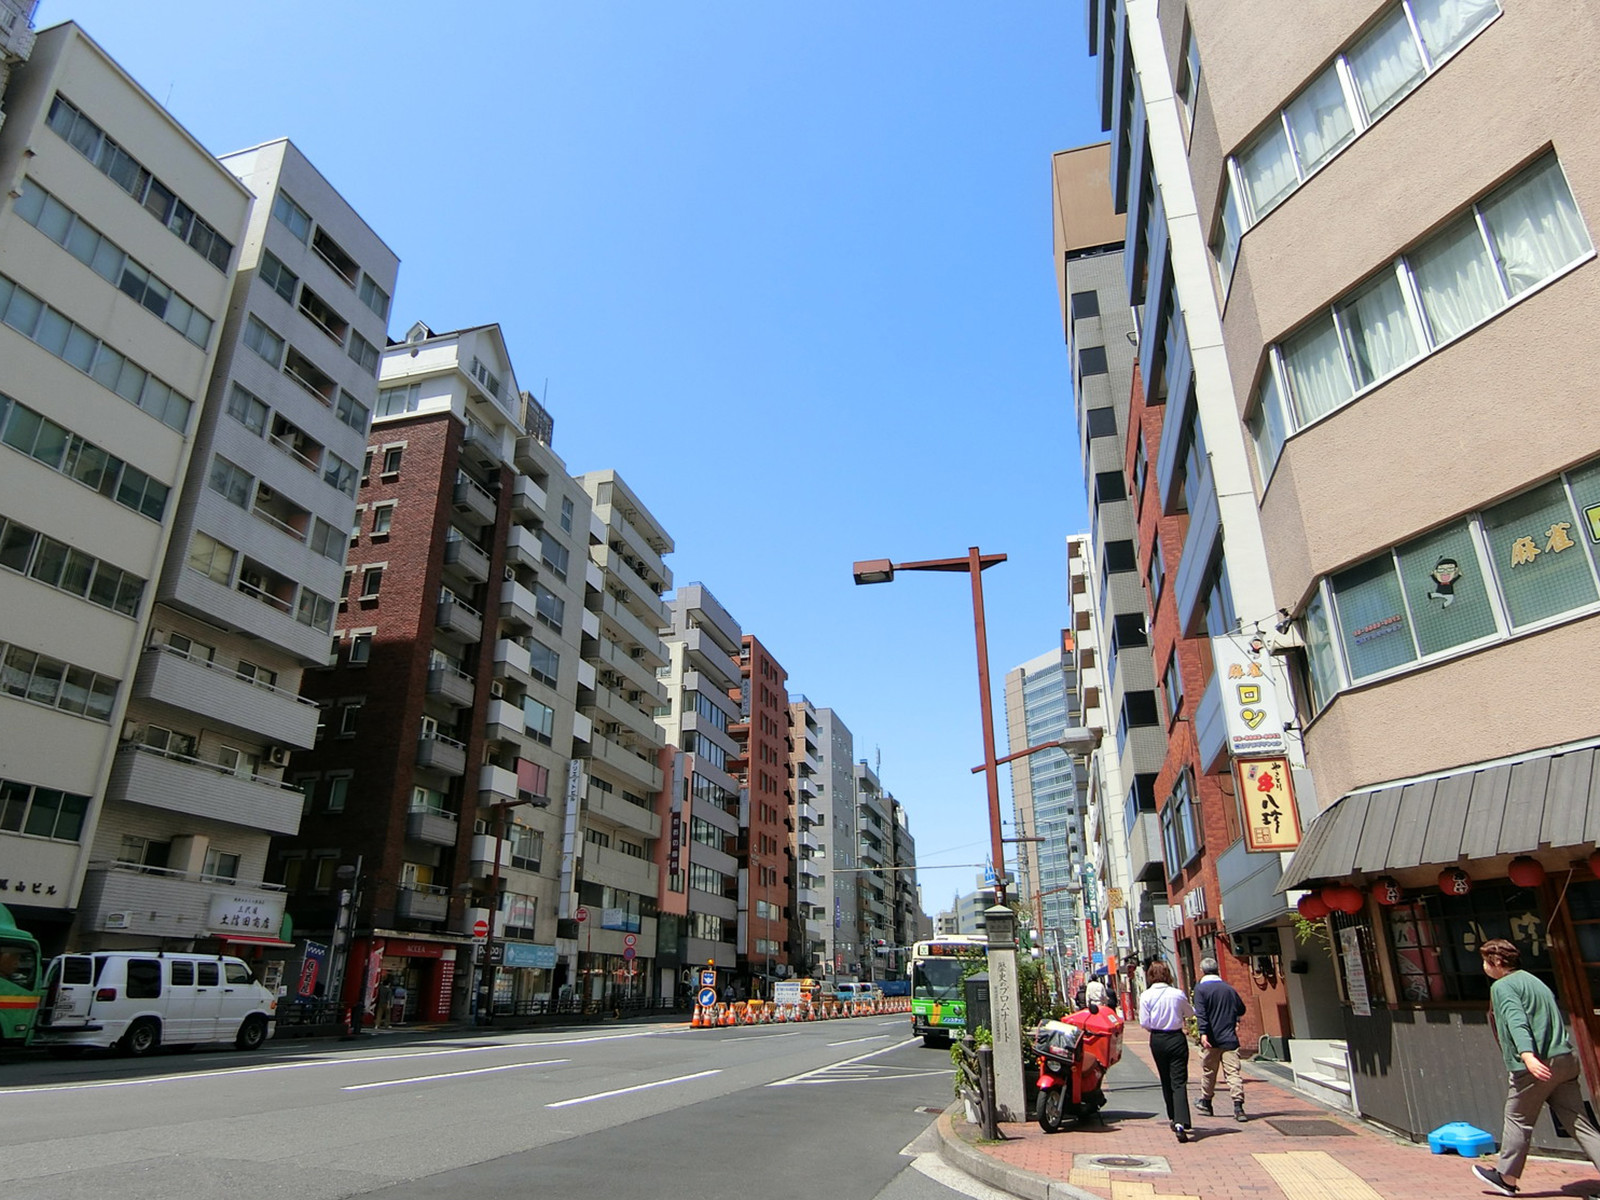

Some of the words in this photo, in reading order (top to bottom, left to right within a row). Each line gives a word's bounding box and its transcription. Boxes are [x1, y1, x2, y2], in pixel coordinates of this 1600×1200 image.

[1511, 521, 1575, 569] 麻雀
[407, 945, 426, 953] ACCEA
[998, 961, 1011, 1043] 歴史のプロムナード
